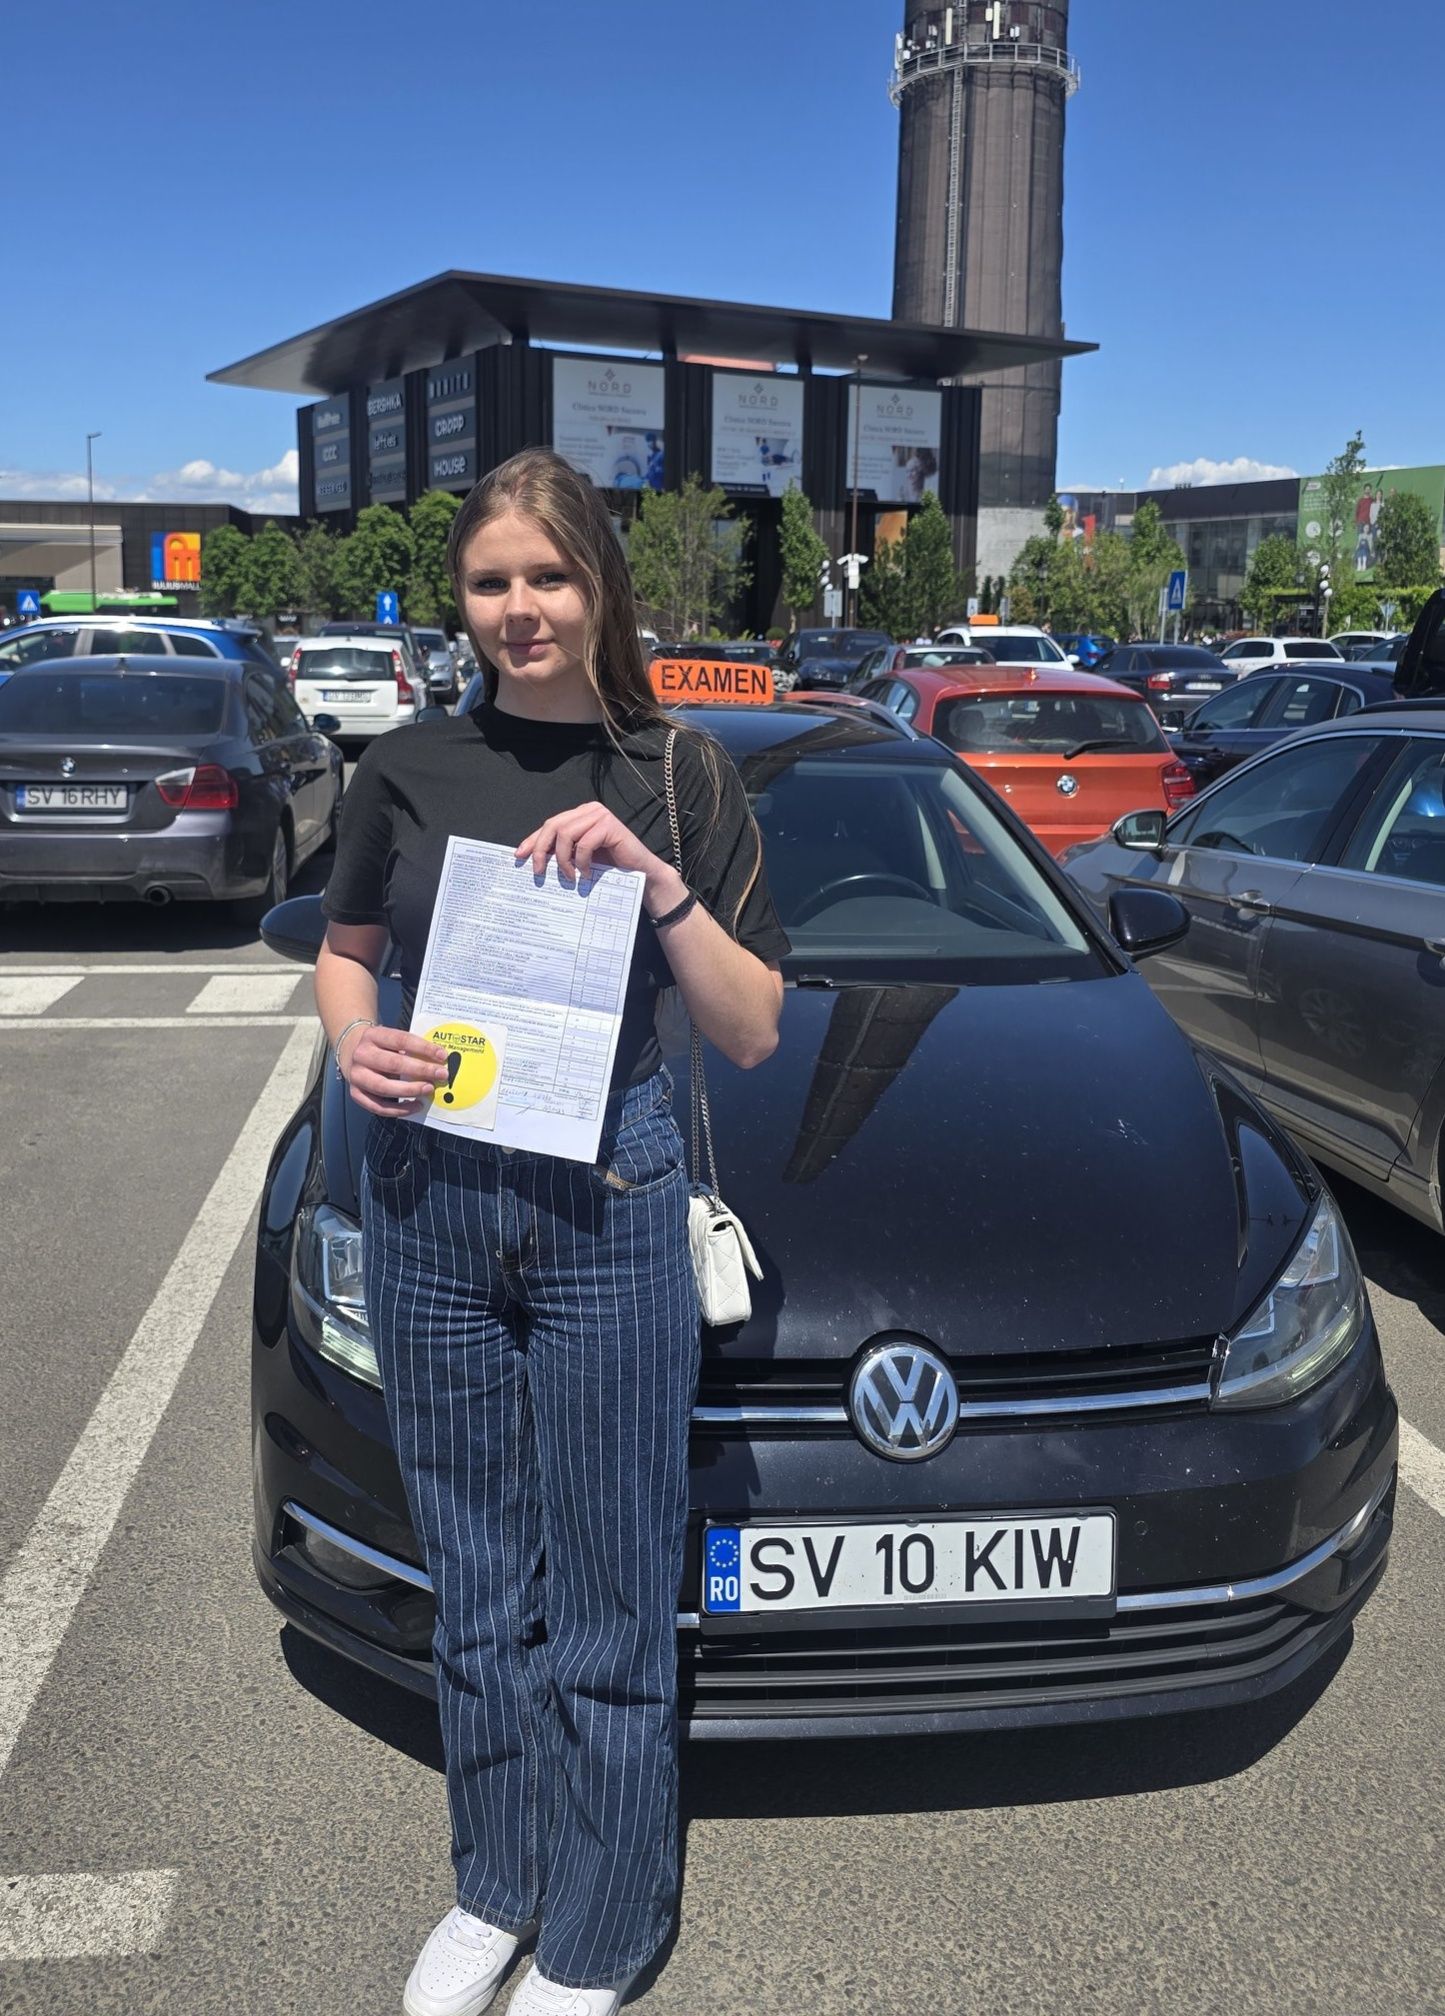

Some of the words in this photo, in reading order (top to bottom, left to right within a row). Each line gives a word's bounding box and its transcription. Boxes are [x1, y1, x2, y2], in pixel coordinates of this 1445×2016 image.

[588, 381, 632, 394] NORD
[367, 393, 402, 416] BERSHKA
[738, 394, 778, 406] NORD
[877, 405, 914, 416] NORD
[434, 414, 464, 437] CROPP
[661, 664, 767, 695] EXAMEN
[28, 787, 54, 805] SV
[61, 787, 78, 805] 16
[81, 787, 122, 805] RHY
[854, 1345, 957, 1455] VW
[710, 1576, 739, 1601] RO
[750, 1535, 845, 1600] SV
[875, 1533, 935, 1595] 10
[964, 1526, 1082, 1593] KIW
